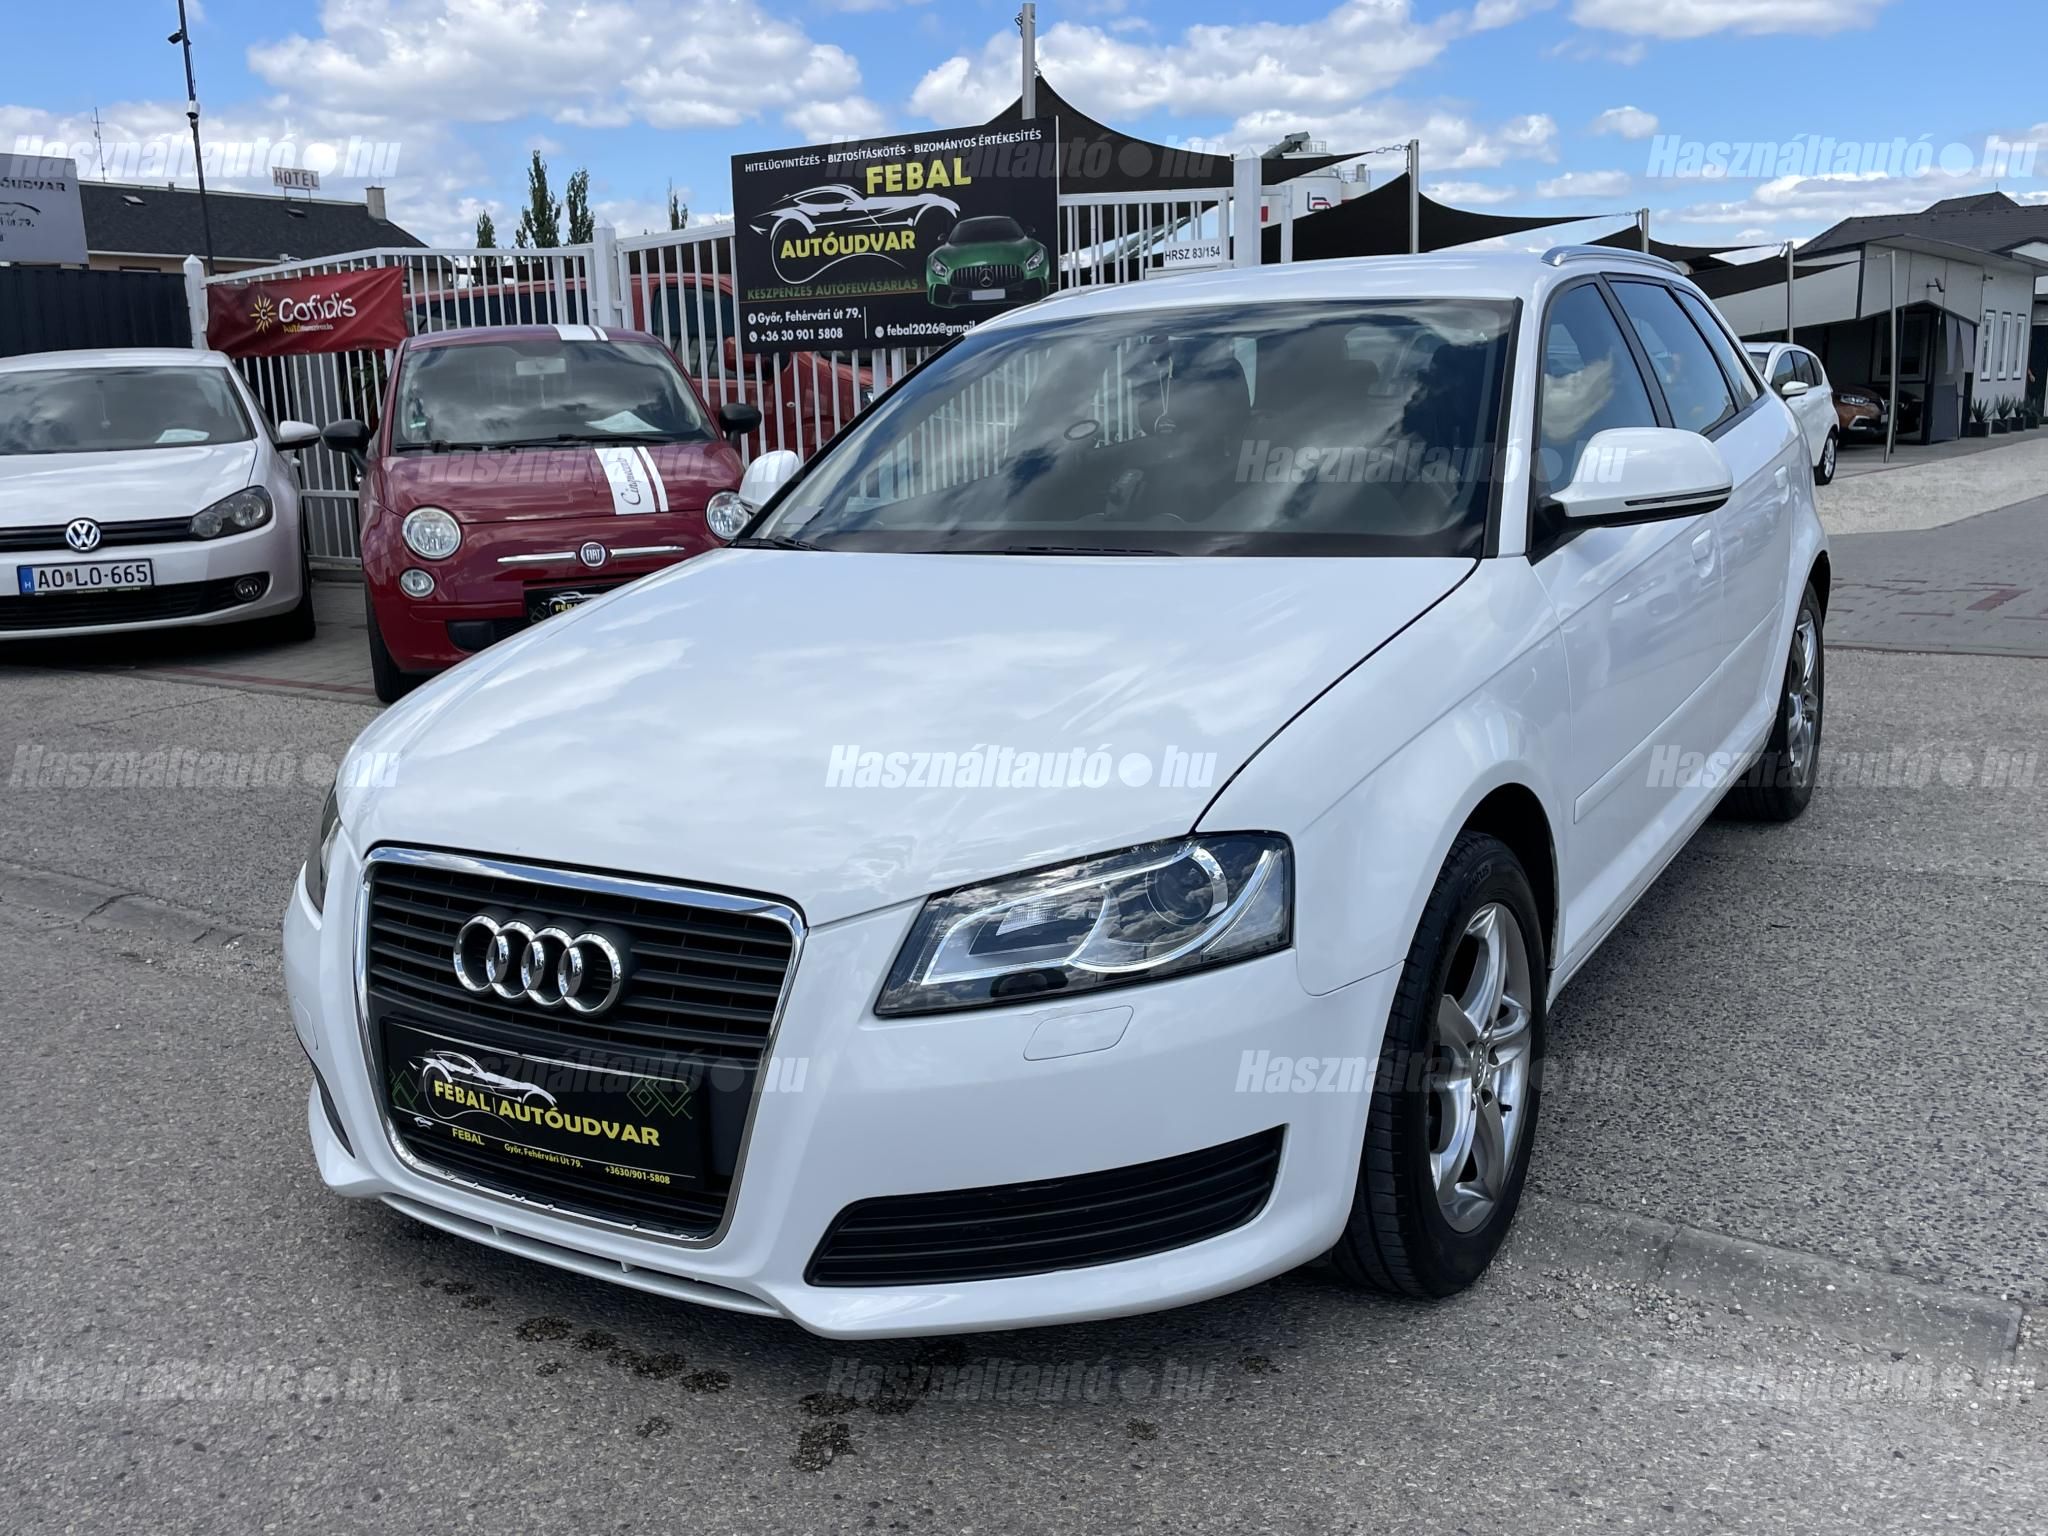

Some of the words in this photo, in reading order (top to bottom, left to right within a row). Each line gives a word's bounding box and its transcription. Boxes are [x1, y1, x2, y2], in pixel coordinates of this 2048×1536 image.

[745, 154, 820, 172] HITELÜGYINTÉZÉS
[828, 145, 906, 164] BIZTOSÍTÁSKÖTÉS
[914, 136, 977, 153] BIZOMÁNYOS
[978, 129, 1042, 146] ÉRTÉKESÍTÉS
[274, 170, 319, 187] HOTEL
[866, 157, 972, 194] FEBAL
[780, 230, 915, 259] AUTÓUDVAR
[1165, 249, 1190, 261] HRSZ
[1192, 245, 1220, 259] 83/154
[279, 292, 356, 322] Cofidis
[786, 309, 831, 322] Fehérvári
[833, 307, 843, 320] út
[845, 308, 862, 319] 79.
[761, 331, 779, 342] +36
[781, 330, 794, 341] 30
[796, 329, 814, 340] 901
[818, 328, 843, 339] 5808
[585, 549, 600, 561] FIAT
[434, 1080, 490, 1113] FEBAL
[499, 1100, 660, 1146] AUTÓUDVAR
[452, 1128, 485, 1145] FEBAL
[605, 1165, 671, 1184] +3630/901-5808
